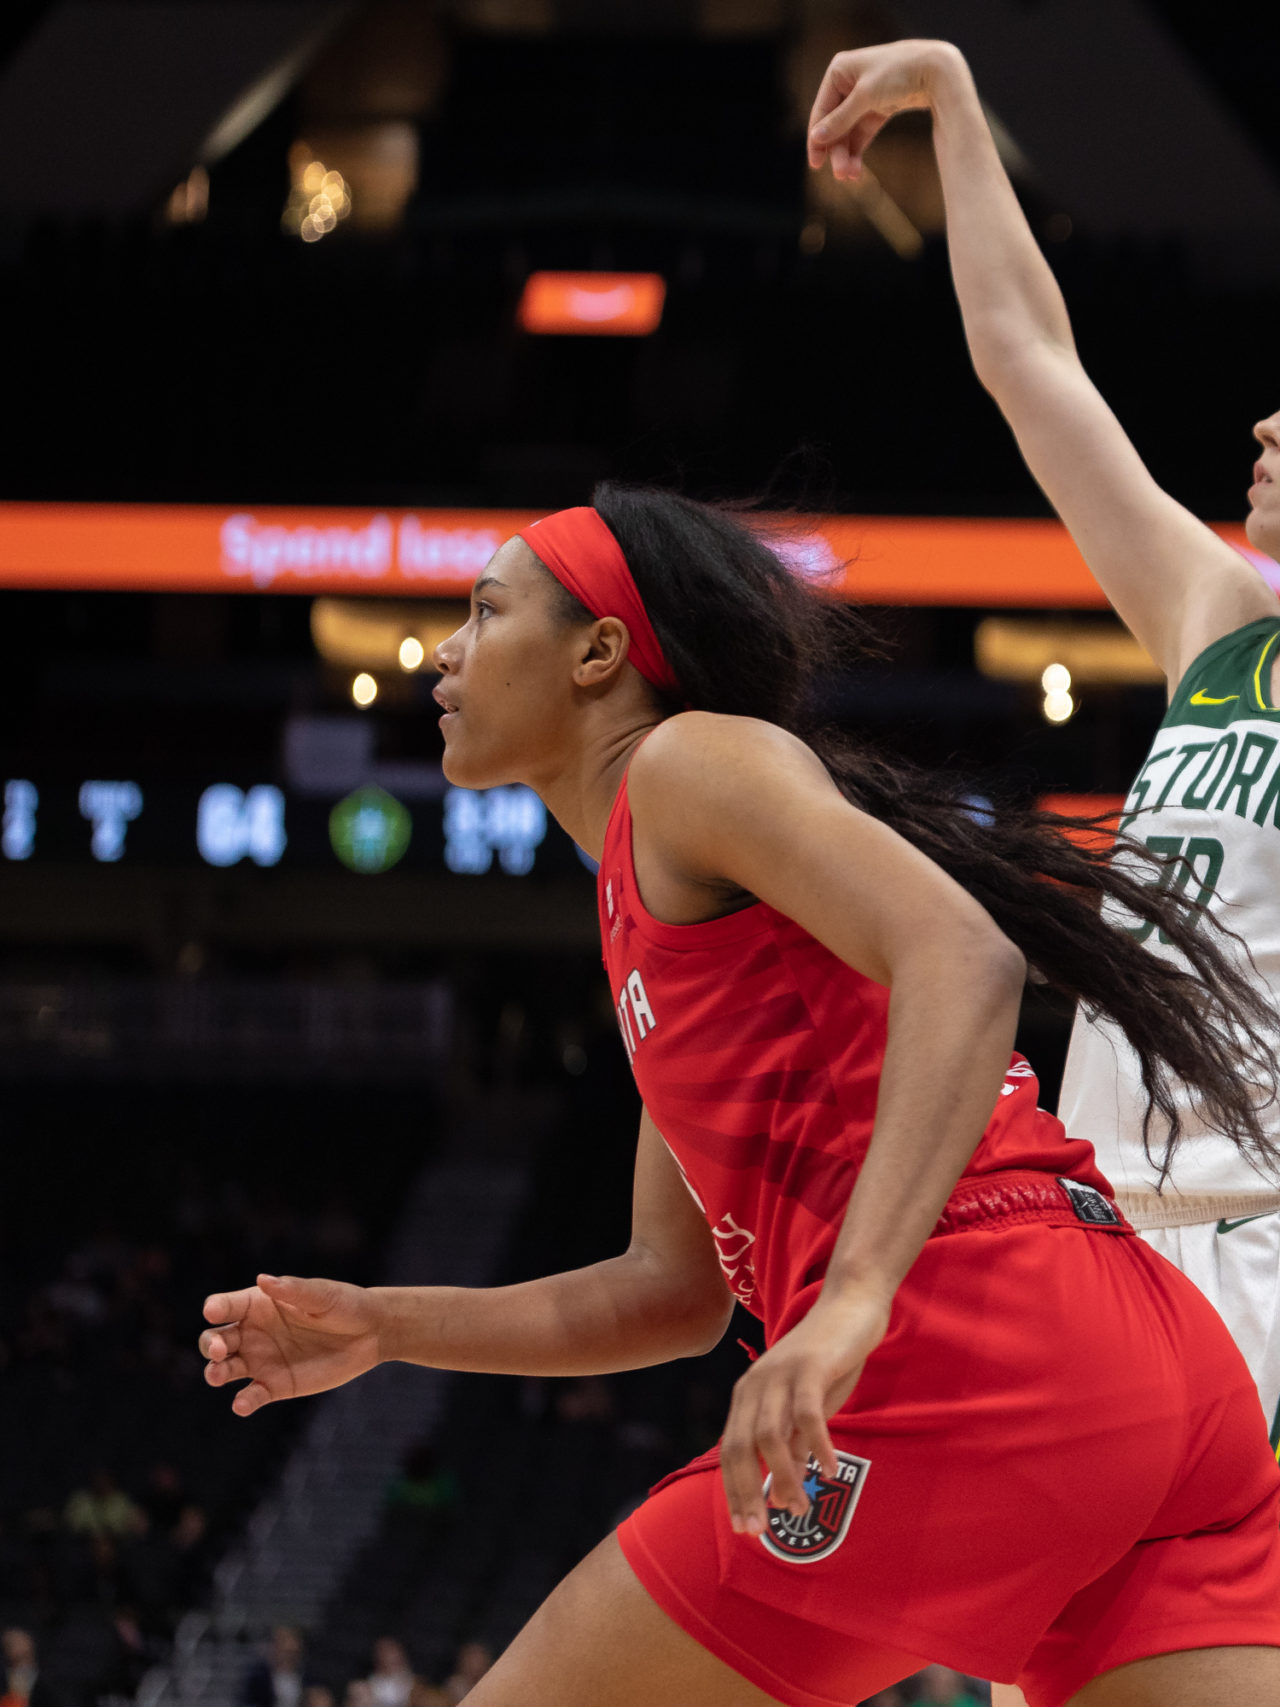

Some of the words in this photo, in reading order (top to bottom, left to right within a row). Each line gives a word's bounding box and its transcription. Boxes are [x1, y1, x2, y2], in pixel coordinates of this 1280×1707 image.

[220, 513, 392, 588] Spend
[197, 783, 287, 867] 64
[770, 1517, 825, 1547] DREAM
